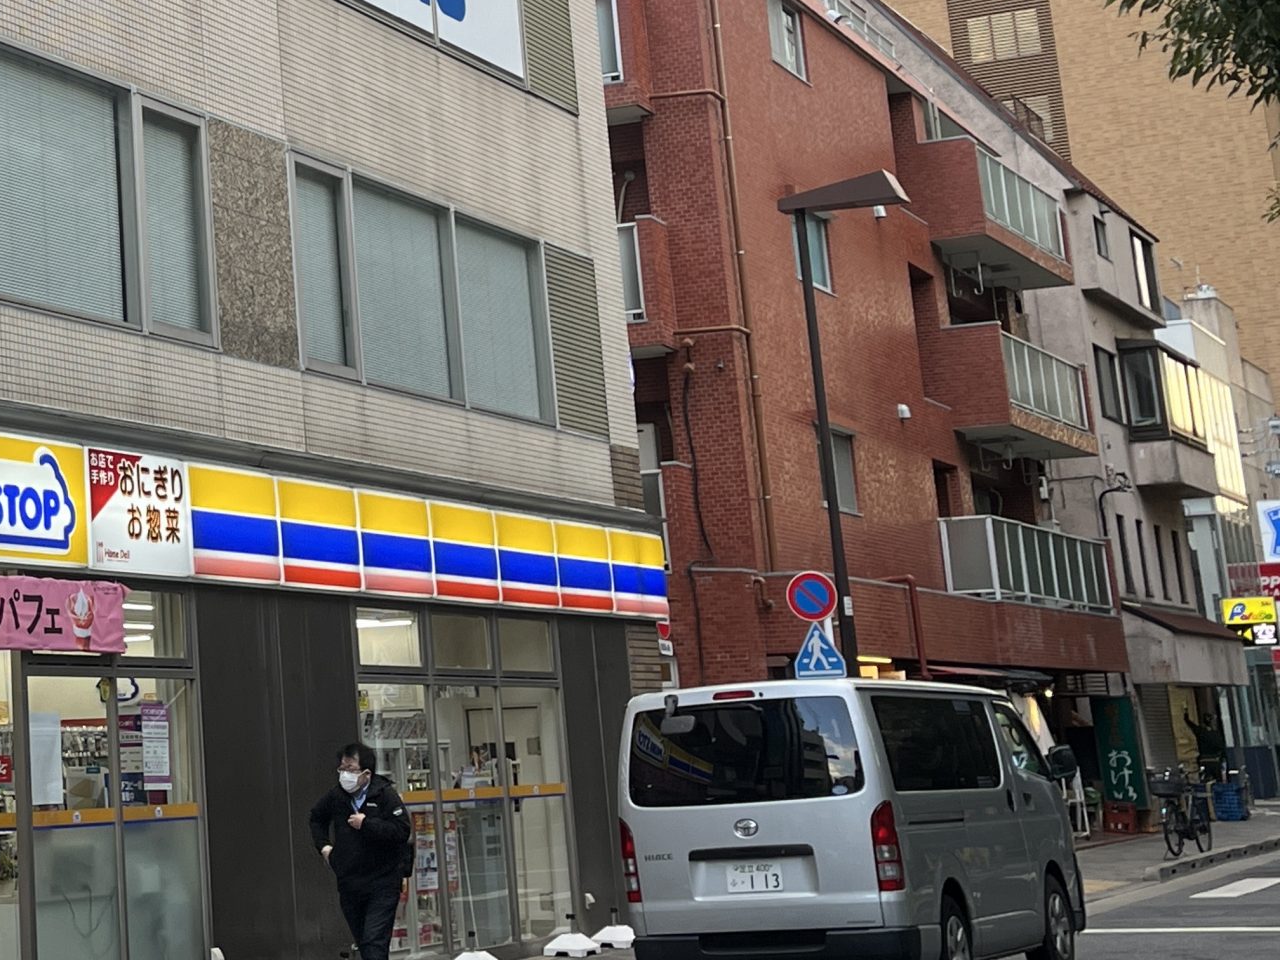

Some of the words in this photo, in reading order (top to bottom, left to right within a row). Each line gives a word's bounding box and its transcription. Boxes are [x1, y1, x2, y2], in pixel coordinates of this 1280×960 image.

[90, 453, 114, 469] お店で
[91, 469, 115, 486] 手作り
[118, 461, 184, 502] おにぎり
[127, 503, 181, 544] お惣菜
[644, 853, 673, 862] HIACE
